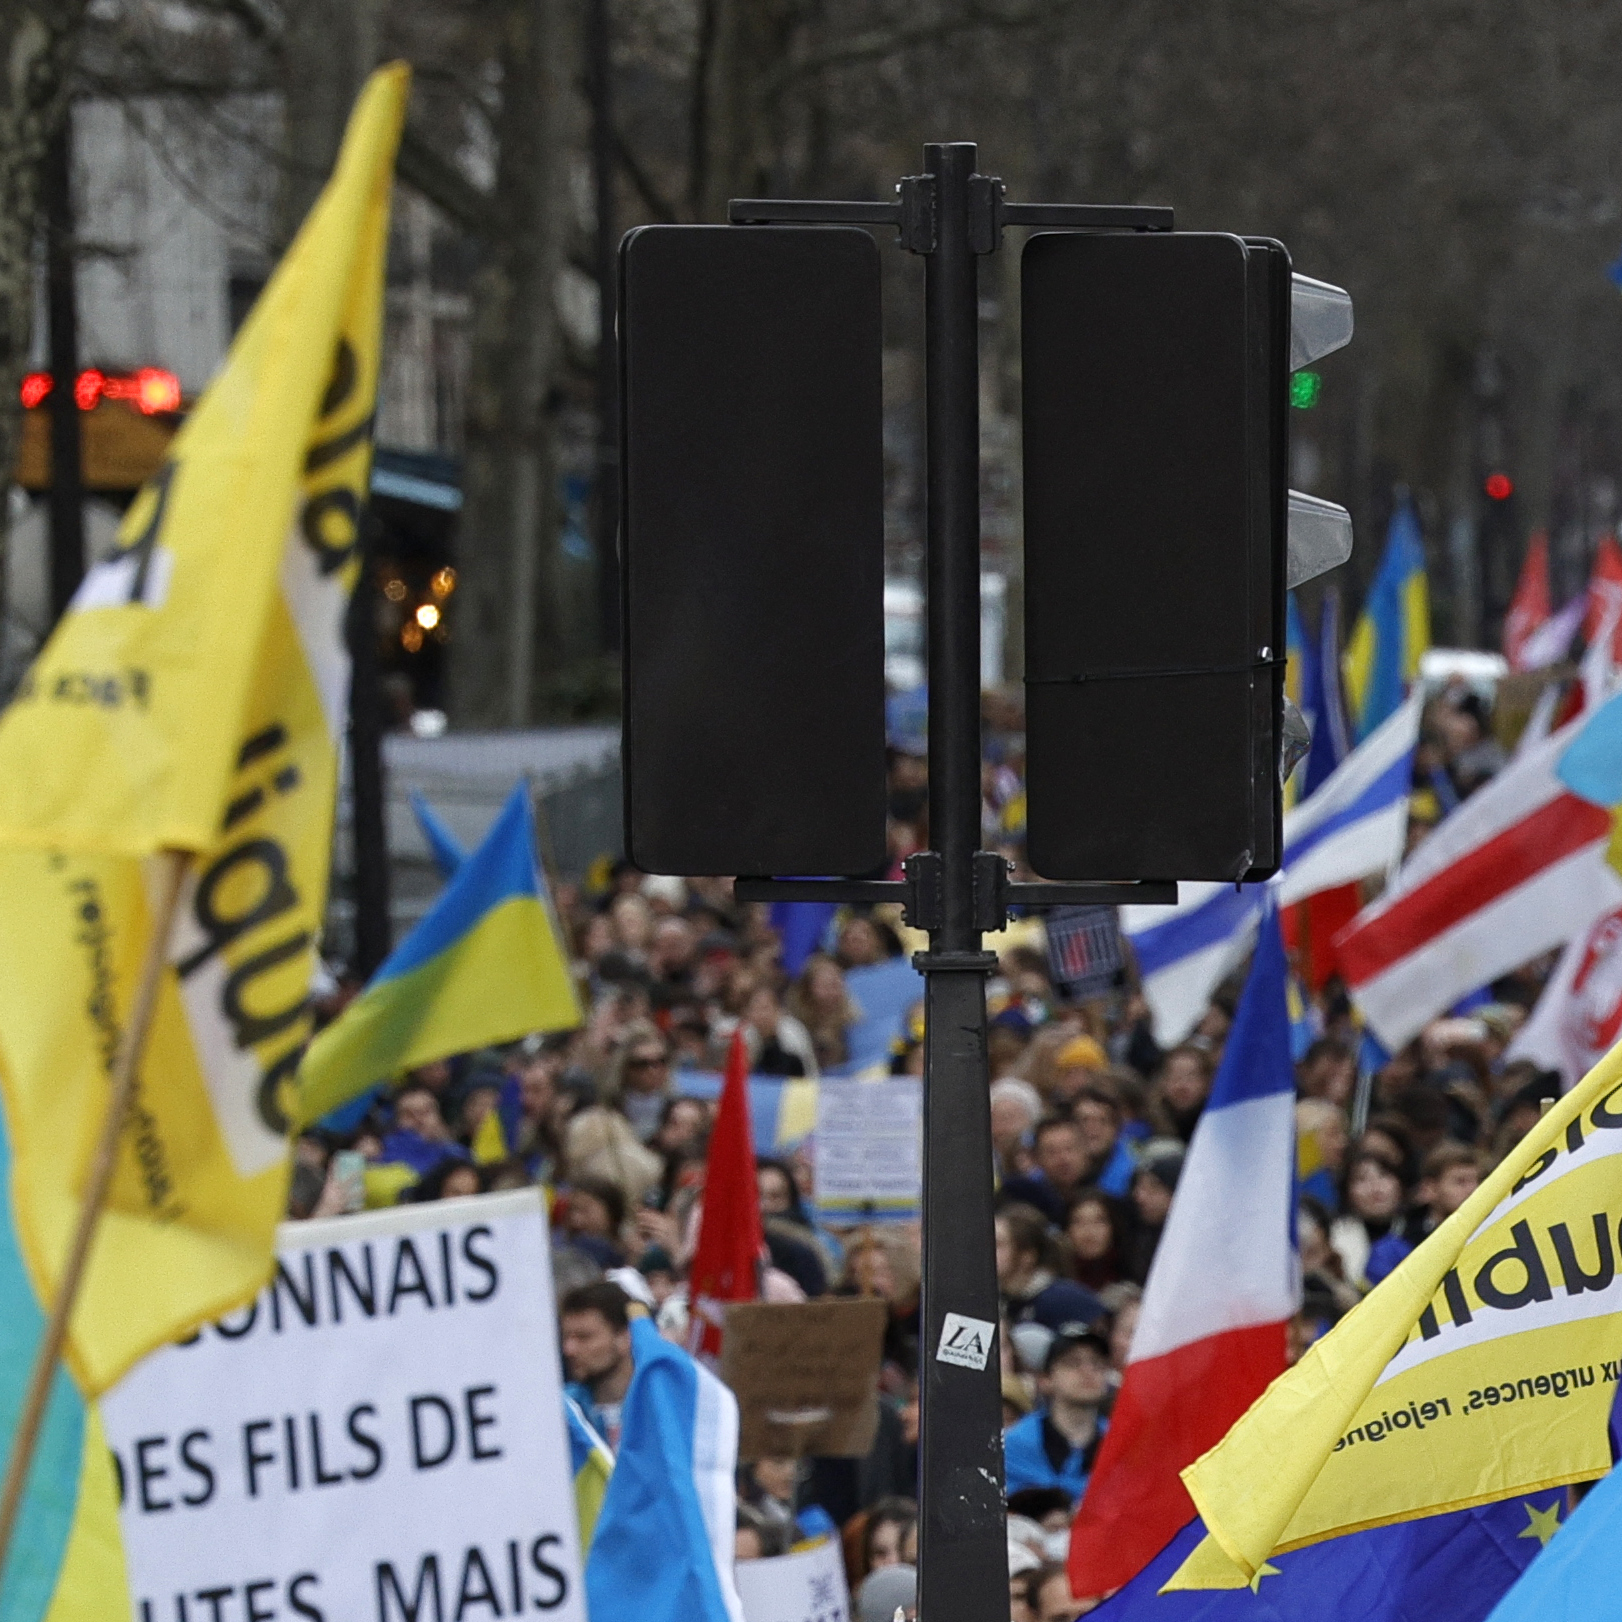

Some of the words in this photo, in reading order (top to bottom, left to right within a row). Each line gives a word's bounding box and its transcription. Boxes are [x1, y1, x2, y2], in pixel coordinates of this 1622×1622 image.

[173, 1226, 500, 1350] NNAIS
[242, 1403, 385, 1498] FILS
[407, 1385, 504, 1471] DE
